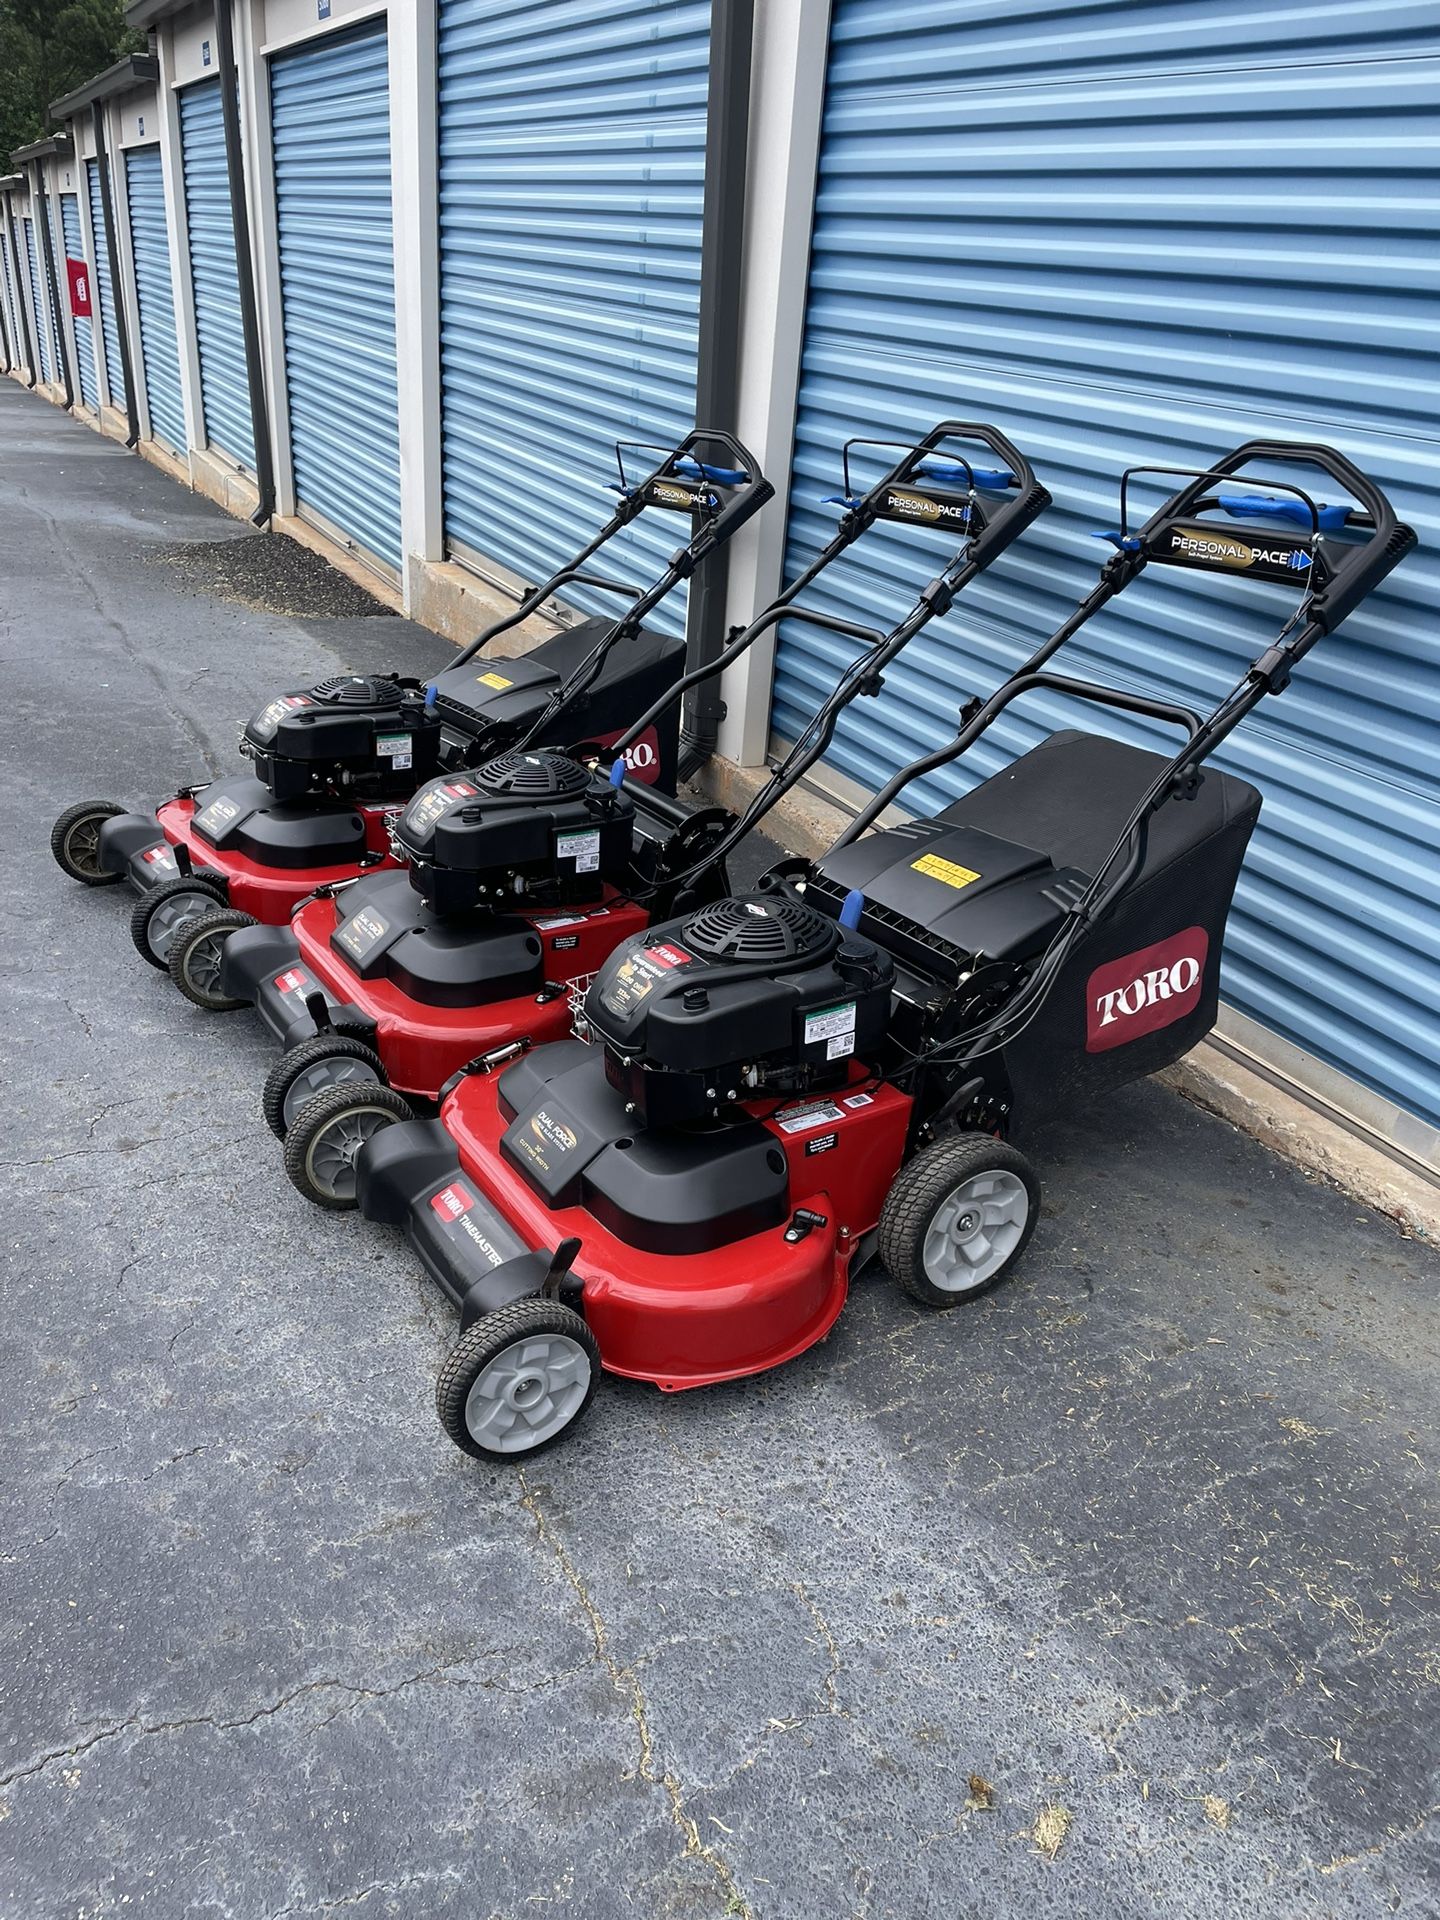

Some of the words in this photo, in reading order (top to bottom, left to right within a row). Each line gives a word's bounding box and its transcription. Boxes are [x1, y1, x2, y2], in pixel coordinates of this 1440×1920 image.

[653, 487, 688, 500] PERSONAL
[689, 493, 707, 504] PACE
[888, 496, 935, 513] PERSONAL
[937, 504, 963, 518] PACE
[1171, 536, 1246, 558] PERSONAL
[1250, 548, 1291, 565] PACE
[632, 954, 667, 978] Guaranteed
[656, 947, 682, 965] TORO
[1097, 957, 1199, 1028] TORO
[538, 1111, 555, 1129] DUAL
[552, 1126, 575, 1149] FORCE
[441, 1189, 465, 1217] TORO
[459, 1214, 504, 1267] TIMEMASTER
